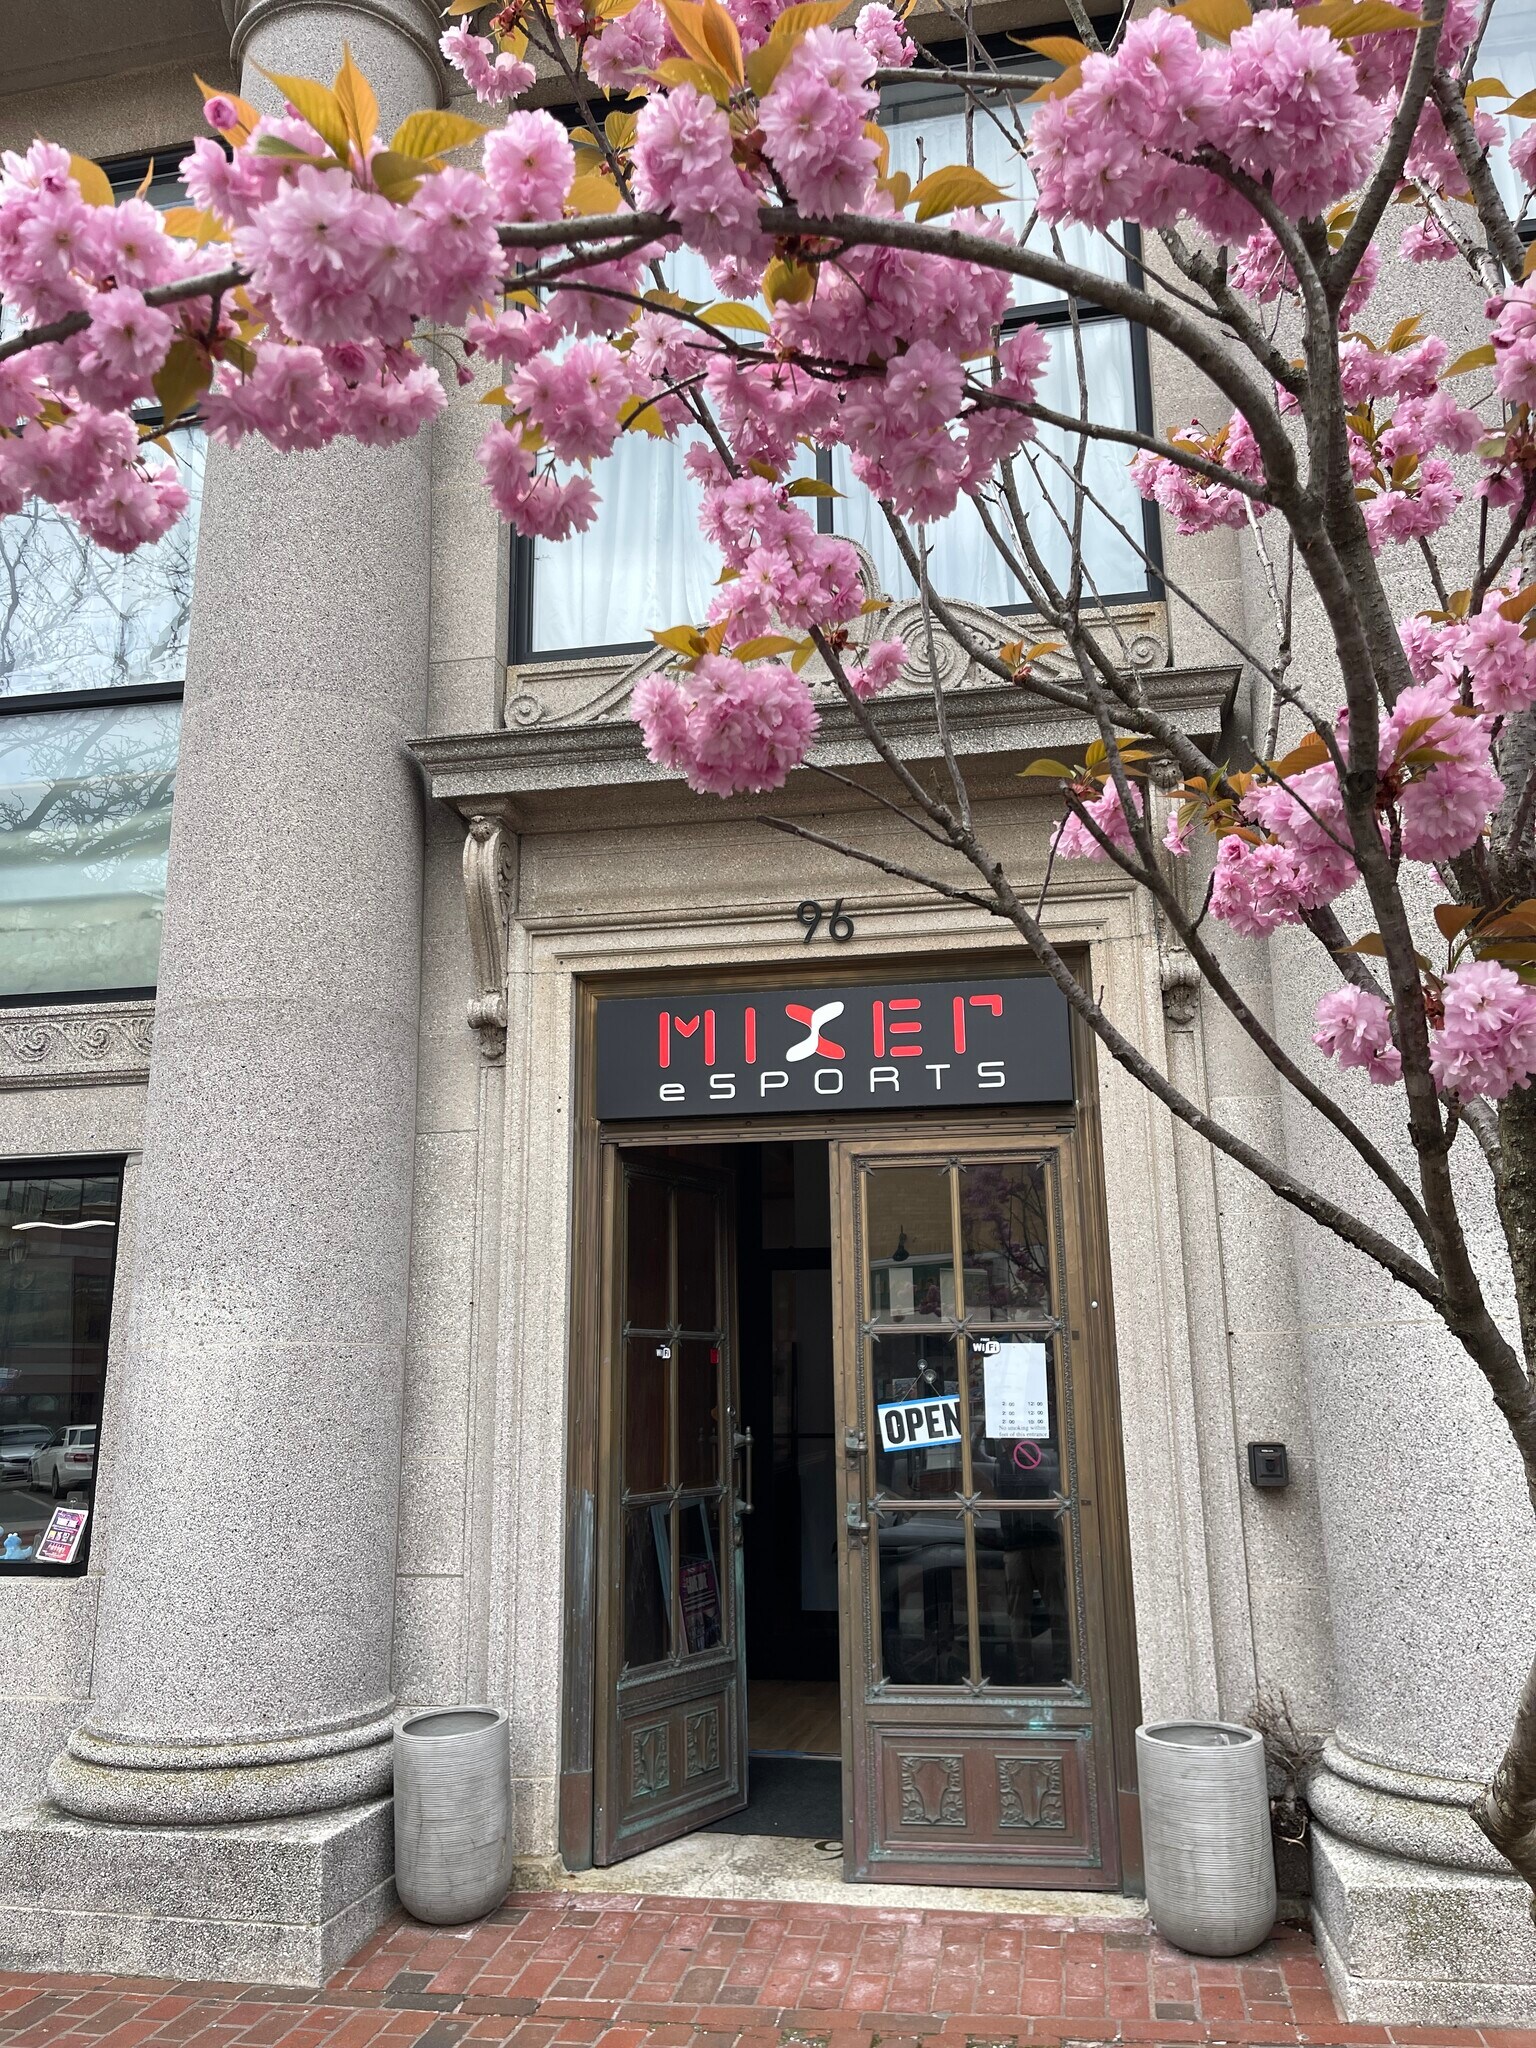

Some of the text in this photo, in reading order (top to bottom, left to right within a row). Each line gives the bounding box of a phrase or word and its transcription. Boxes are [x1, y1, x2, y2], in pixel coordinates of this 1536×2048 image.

[796, 898, 854, 943] 96
[660, 1061, 1005, 1101] eSPORTS
[884, 1402, 962, 1444] OPEN
